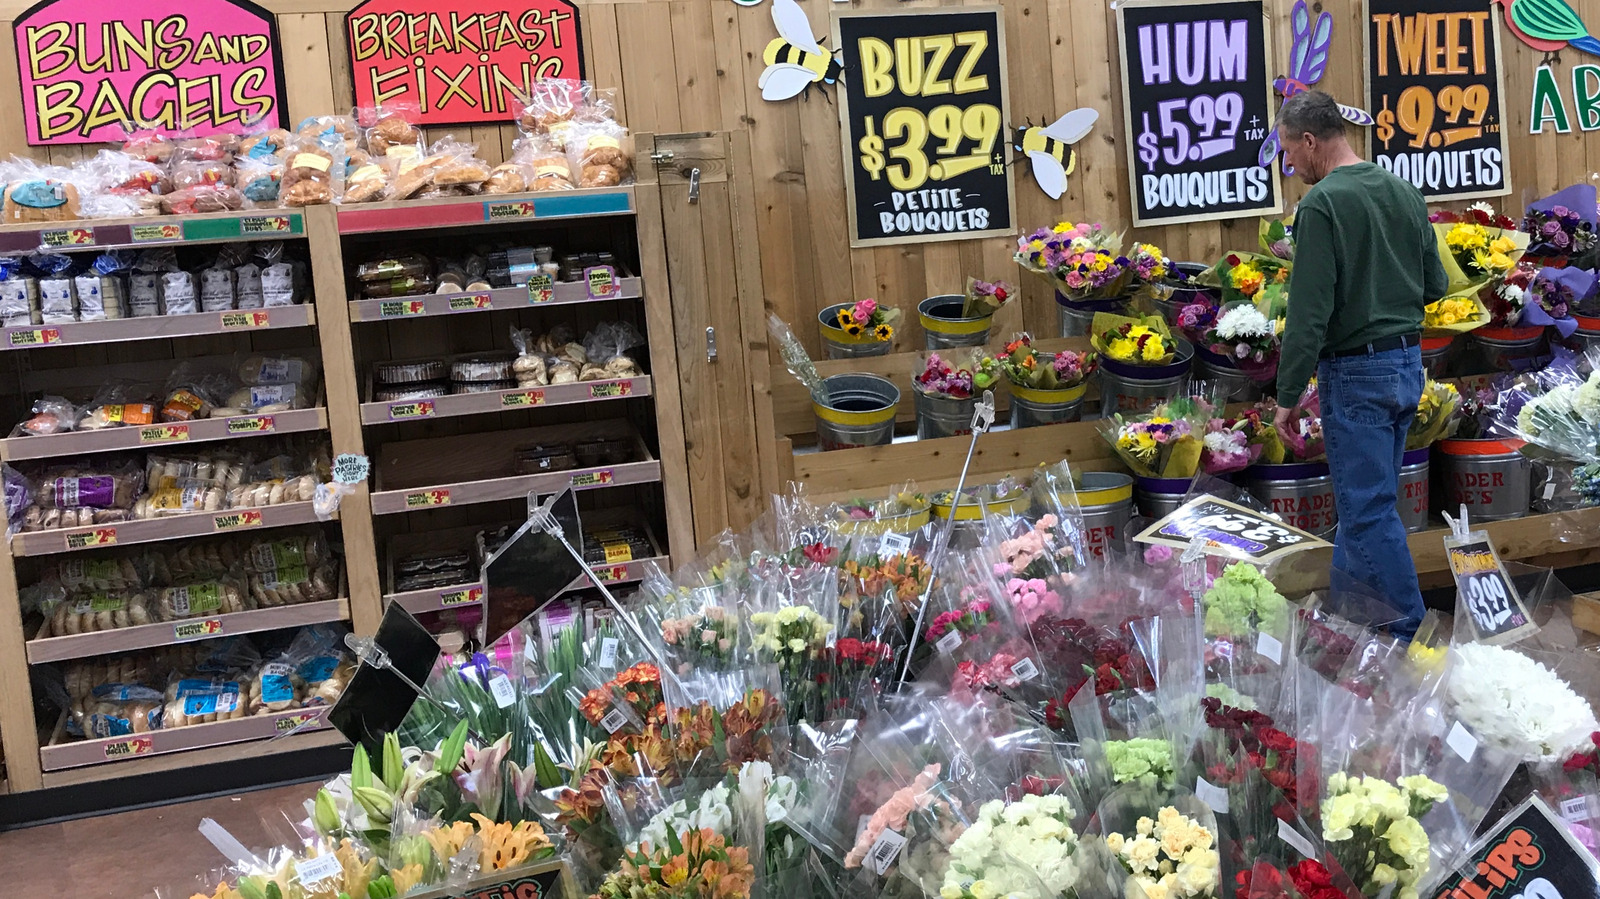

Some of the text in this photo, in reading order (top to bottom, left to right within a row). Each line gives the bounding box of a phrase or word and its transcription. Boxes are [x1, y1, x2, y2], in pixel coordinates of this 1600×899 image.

[26, 14, 269, 80] BUNS AND
[352, 9, 571, 61] BREAKFAST
[1138, 19, 1248, 85] HUM
[1372, 11, 1489, 76] TWEET
[858, 30, 989, 98] BUZZ
[34, 67, 274, 140] BAGELS
[1376, 84, 1490, 150] $9.99
[1485, 124, 1500, 133] TAX
[859, 103, 1001, 191] $3.99
[1138, 91, 1245, 171] $5.99
[1244, 128, 1265, 141] TAX
[989, 164, 1004, 175] TAX
[1142, 166, 1269, 210] BOUQUETS
[879, 207, 990, 233] BOUQUETS
[892, 188, 963, 211] PETiTE
[337, 457, 357, 466] MORE
[1453, 472, 1504, 488] ADER
[1272, 492, 1335, 513] TRADE
[1467, 574, 1512, 631] $3.99
